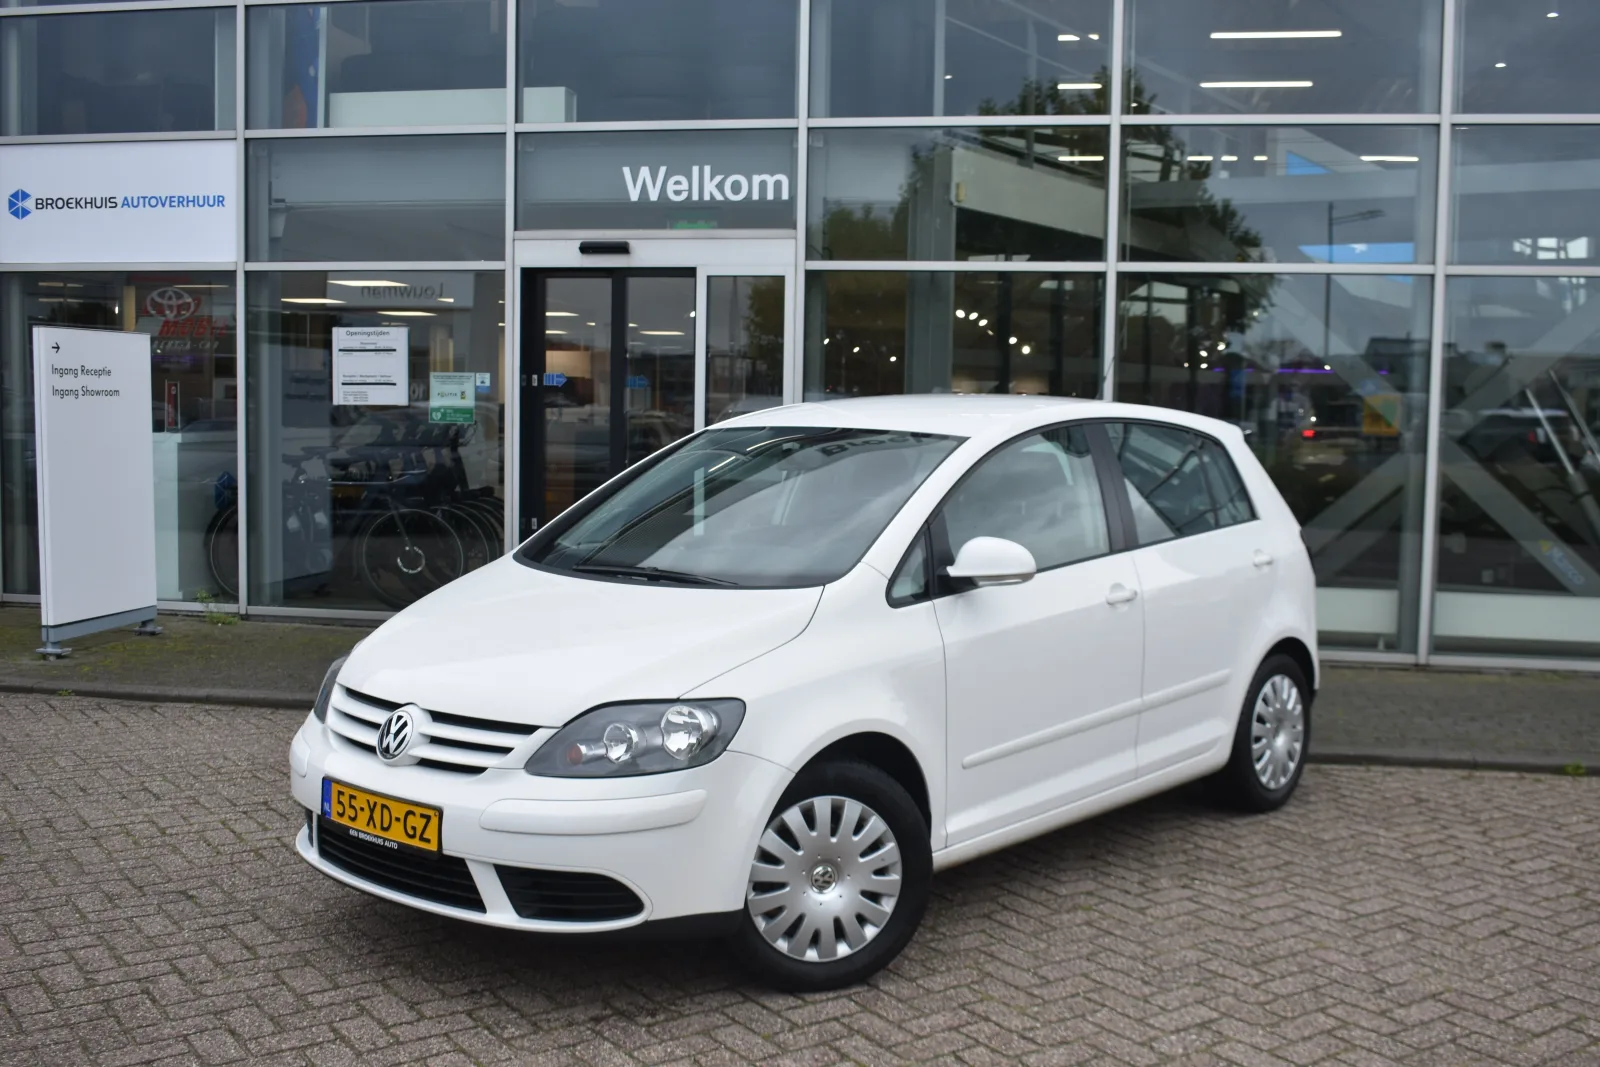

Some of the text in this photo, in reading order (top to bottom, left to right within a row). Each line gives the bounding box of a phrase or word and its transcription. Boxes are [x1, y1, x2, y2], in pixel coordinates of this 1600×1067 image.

[622, 165, 790, 202] Welkom
[35, 194, 226, 210] BROEKHUIS AUTOVERHUUR
[51, 364, 112, 378] Ingang Receptie
[52, 385, 120, 400] Ingang Showroom
[337, 790, 431, 844] 55-XD-GZ
[384, 840, 398, 850] AUTO
